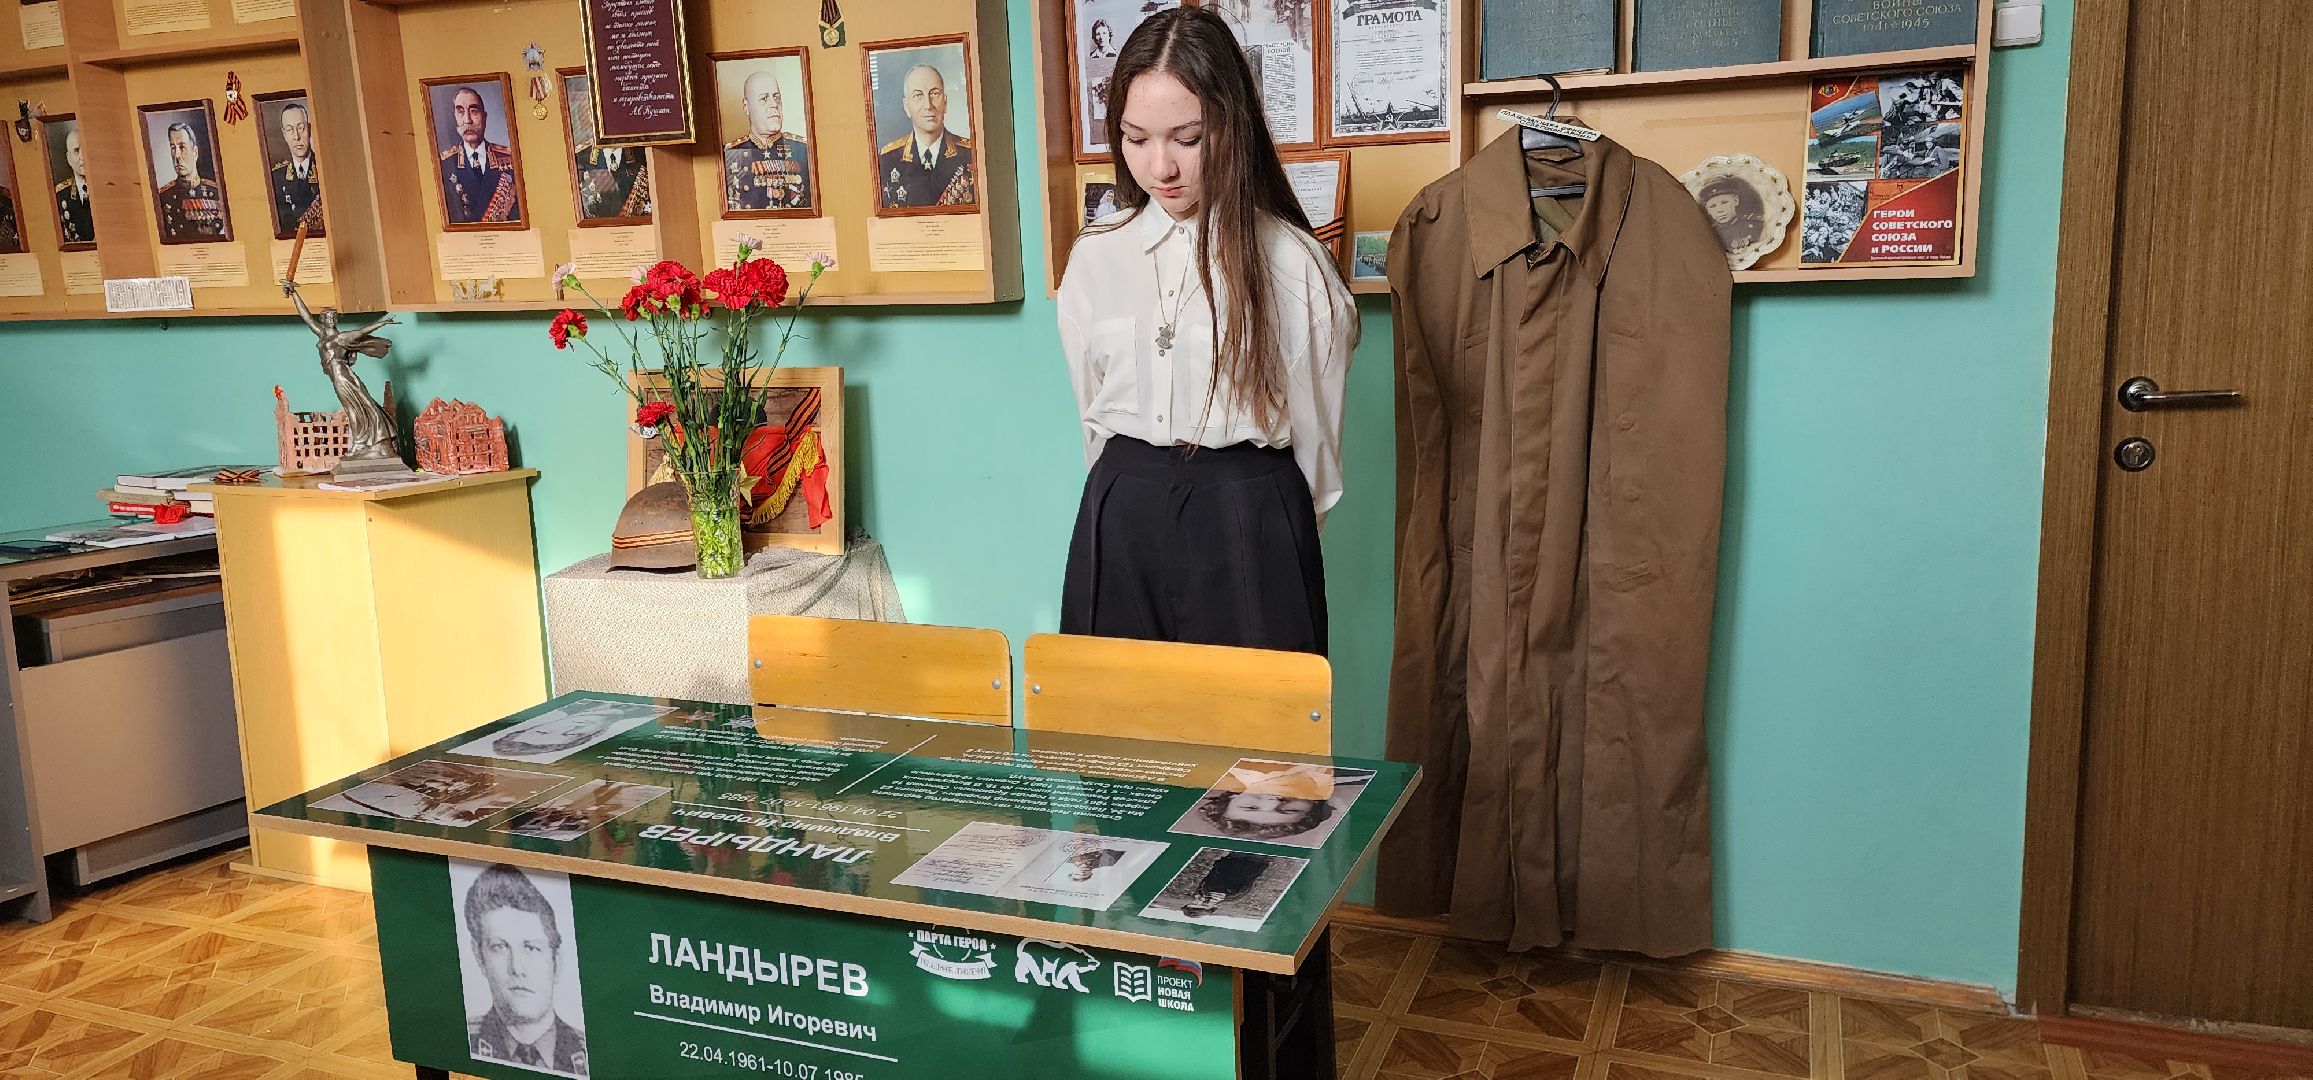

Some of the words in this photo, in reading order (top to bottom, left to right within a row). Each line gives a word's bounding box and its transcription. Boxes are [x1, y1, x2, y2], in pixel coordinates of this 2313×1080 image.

[1357, 10, 1423, 26] ГРАМОТА
[1833, 7, 1914, 24] СОВЕТСКОГО
[1916, 4, 1962, 16] СОЮЗА
[1863, 21, 1887, 32] 1941
[1901, 18, 1930, 31] 1945
[1873, 209, 1915, 218] ГЕРОИ
[1872, 220, 1952, 230] СОВЕТСКОГО
[1872, 233, 1916, 241] СОЮЗА
[1882, 244, 1932, 254] РОССИИ
[672, 808, 782, 827] Игоревич
[776, 819, 901, 842] Владимир
[633, 825, 876, 863] ЛАНДЫРЕВ
[916, 930, 952, 946] ПАРТА
[954, 936, 988, 952] ГЕРОЯ
[648, 932, 868, 997] ЛАНДЫРЕВ
[1157, 975, 1193, 988] ПРОЕКТ
[1158, 987, 1190, 1000] НОВАЯ
[649, 983, 761, 1025] Владимир
[768, 1004, 876, 1042] Игоревич
[1158, 998, 1194, 1012] ШКОЛА
